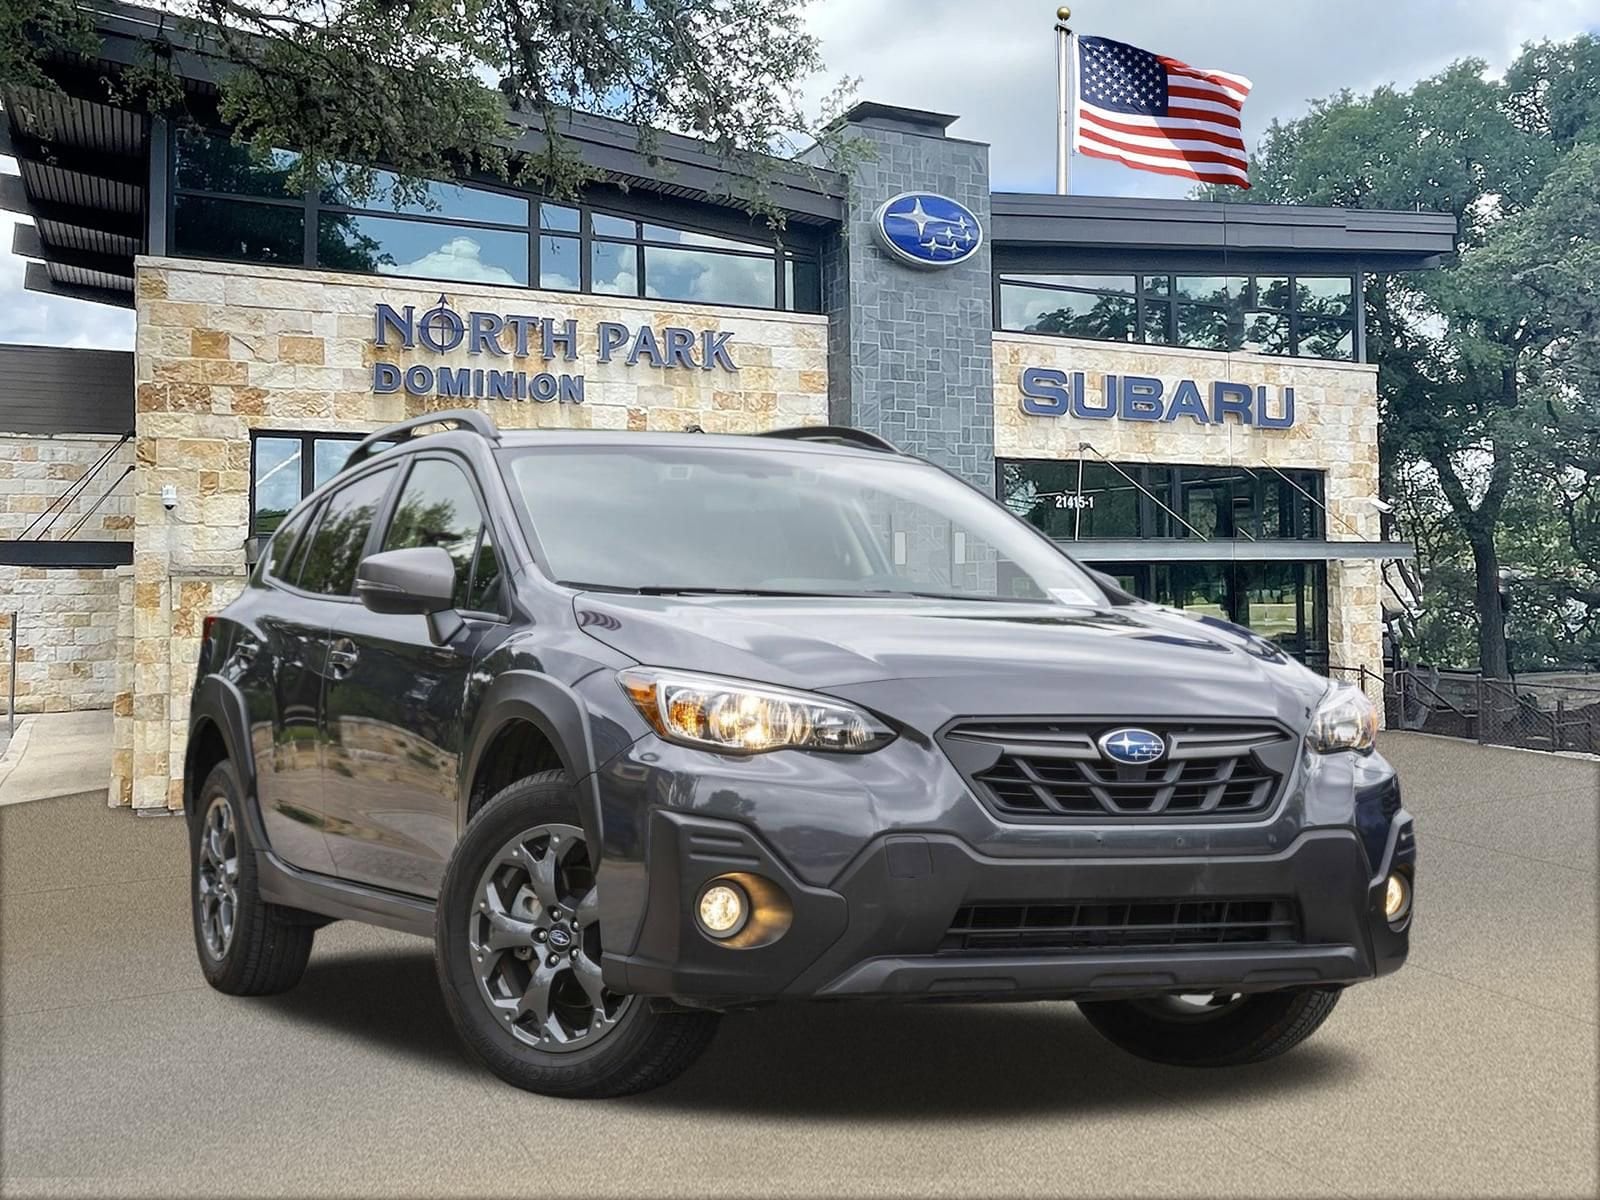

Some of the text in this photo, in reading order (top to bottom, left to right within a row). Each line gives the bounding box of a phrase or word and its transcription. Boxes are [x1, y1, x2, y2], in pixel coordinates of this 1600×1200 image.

[374, 294, 741, 373] NORTH PARK
[373, 362, 585, 404] DOMINION
[1018, 366, 1296, 430] SUBARU
[1055, 495, 1094, 509] 21415-1
